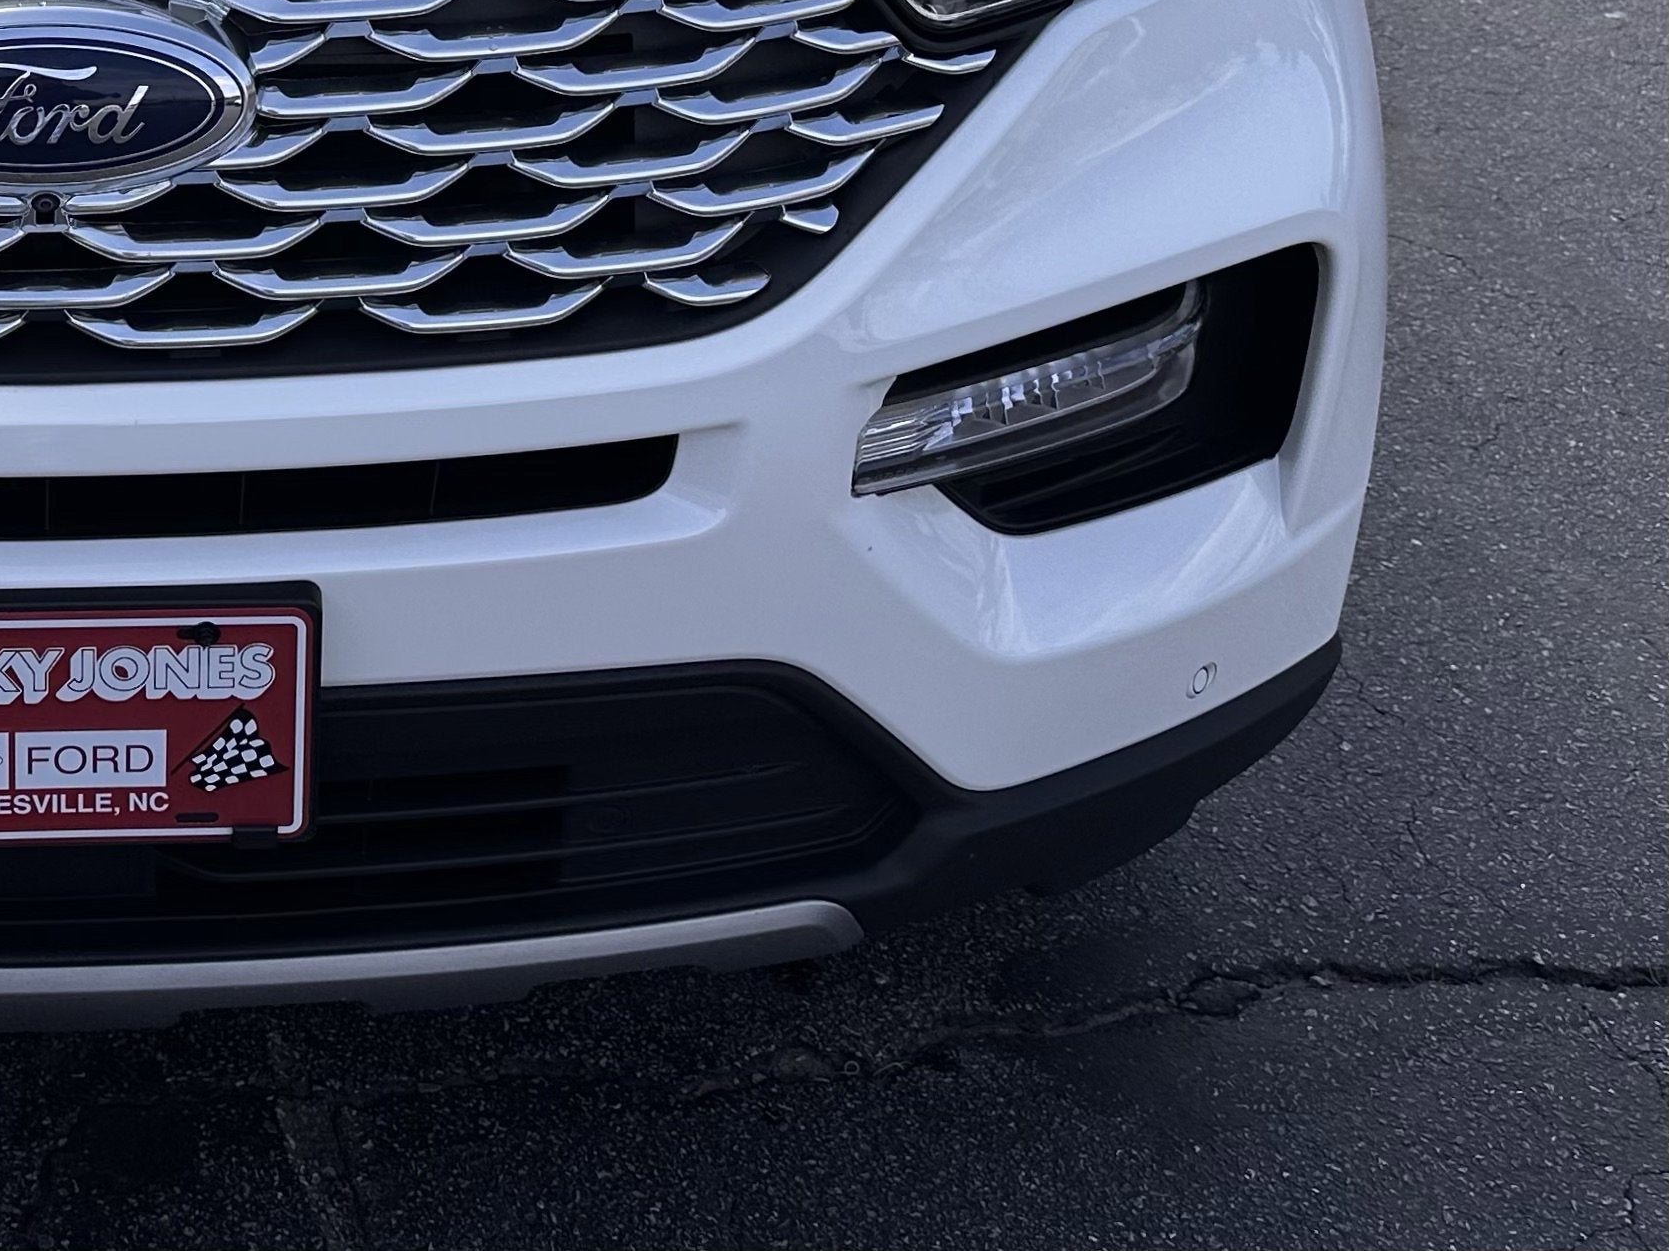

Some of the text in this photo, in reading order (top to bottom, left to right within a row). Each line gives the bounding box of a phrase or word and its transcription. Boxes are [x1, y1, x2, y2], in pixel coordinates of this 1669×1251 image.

[55, 643, 276, 703] JONES
[25, 744, 156, 776] FORD
[129, 792, 169, 812] NC
